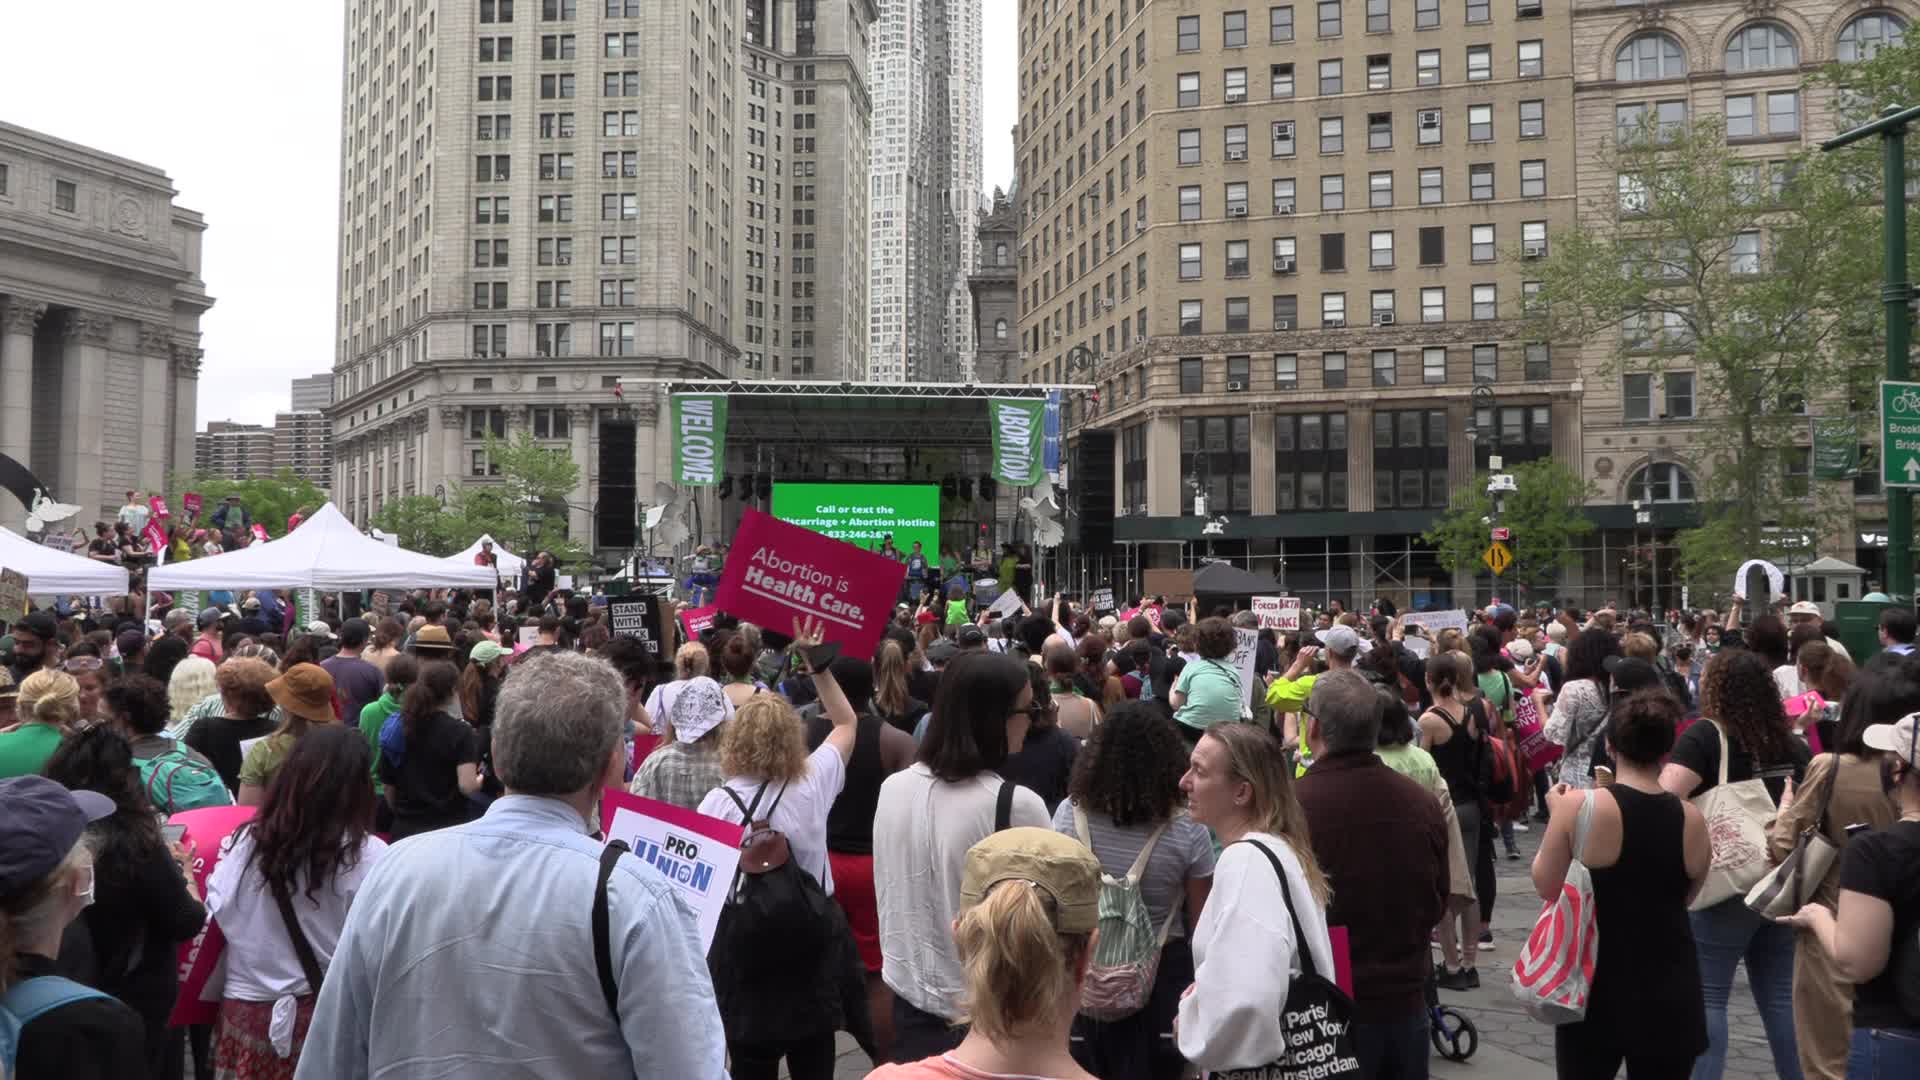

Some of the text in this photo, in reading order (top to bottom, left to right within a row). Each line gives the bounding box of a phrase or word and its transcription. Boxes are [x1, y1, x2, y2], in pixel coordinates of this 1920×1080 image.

[681, 400, 714, 483] WELCOME
[998, 404, 1031, 480] ABORTION
[816, 505, 835, 514] Call
[852, 506, 873, 514] text
[876, 505, 894, 514] the
[782, 517, 838, 529] iscarriage
[850, 517, 895, 527] Abortion
[898, 518, 936, 528] Hotline
[751, 546, 849, 593] Abortion is
[745, 566, 865, 621] Health Care.
[614, 604, 646, 615] STAND
[1257, 614, 1297, 628] VIOLENCE
[615, 616, 641, 628] WITH
[665, 836, 698, 860] PRO
[634, 838, 713, 893] UNION
